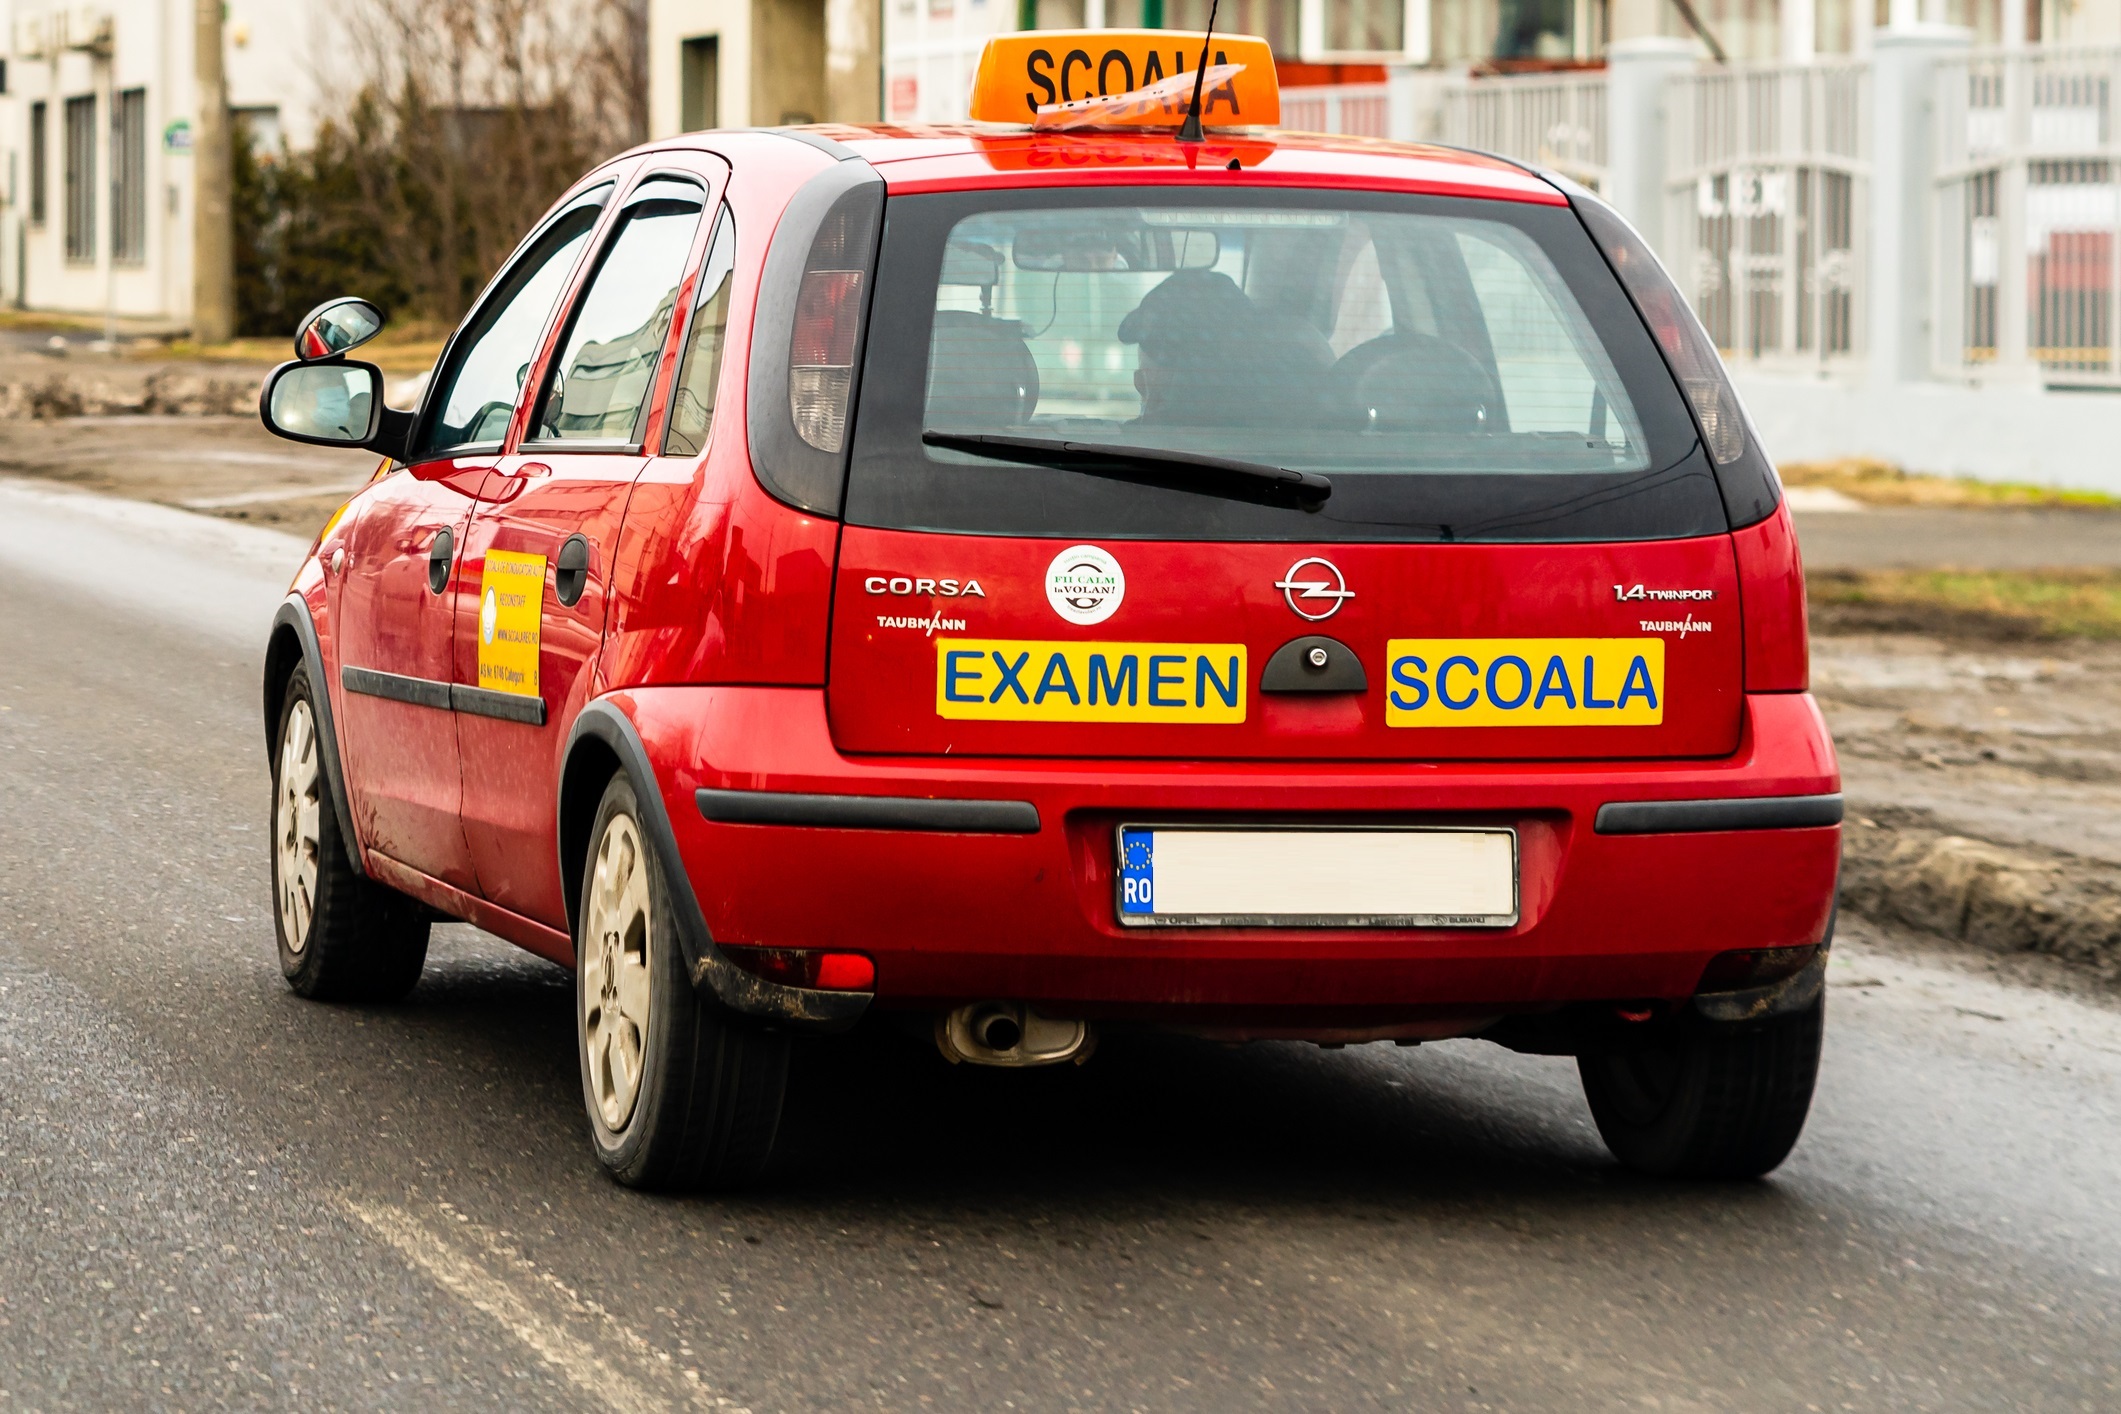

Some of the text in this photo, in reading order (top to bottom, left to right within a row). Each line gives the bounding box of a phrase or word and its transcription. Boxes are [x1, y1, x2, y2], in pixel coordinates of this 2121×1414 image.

[1026, 49, 1240, 115] SCOALA
[864, 576, 986, 597] CORSA
[1054, 575, 1115, 584] FII CALM
[876, 610, 966, 637] TAUBMANN
[1639, 612, 1712, 640] TAUBMANN
[945, 650, 1239, 708] EXAMEN
[1390, 655, 1658, 710] SCOALA
[1124, 877, 1152, 904] RO
